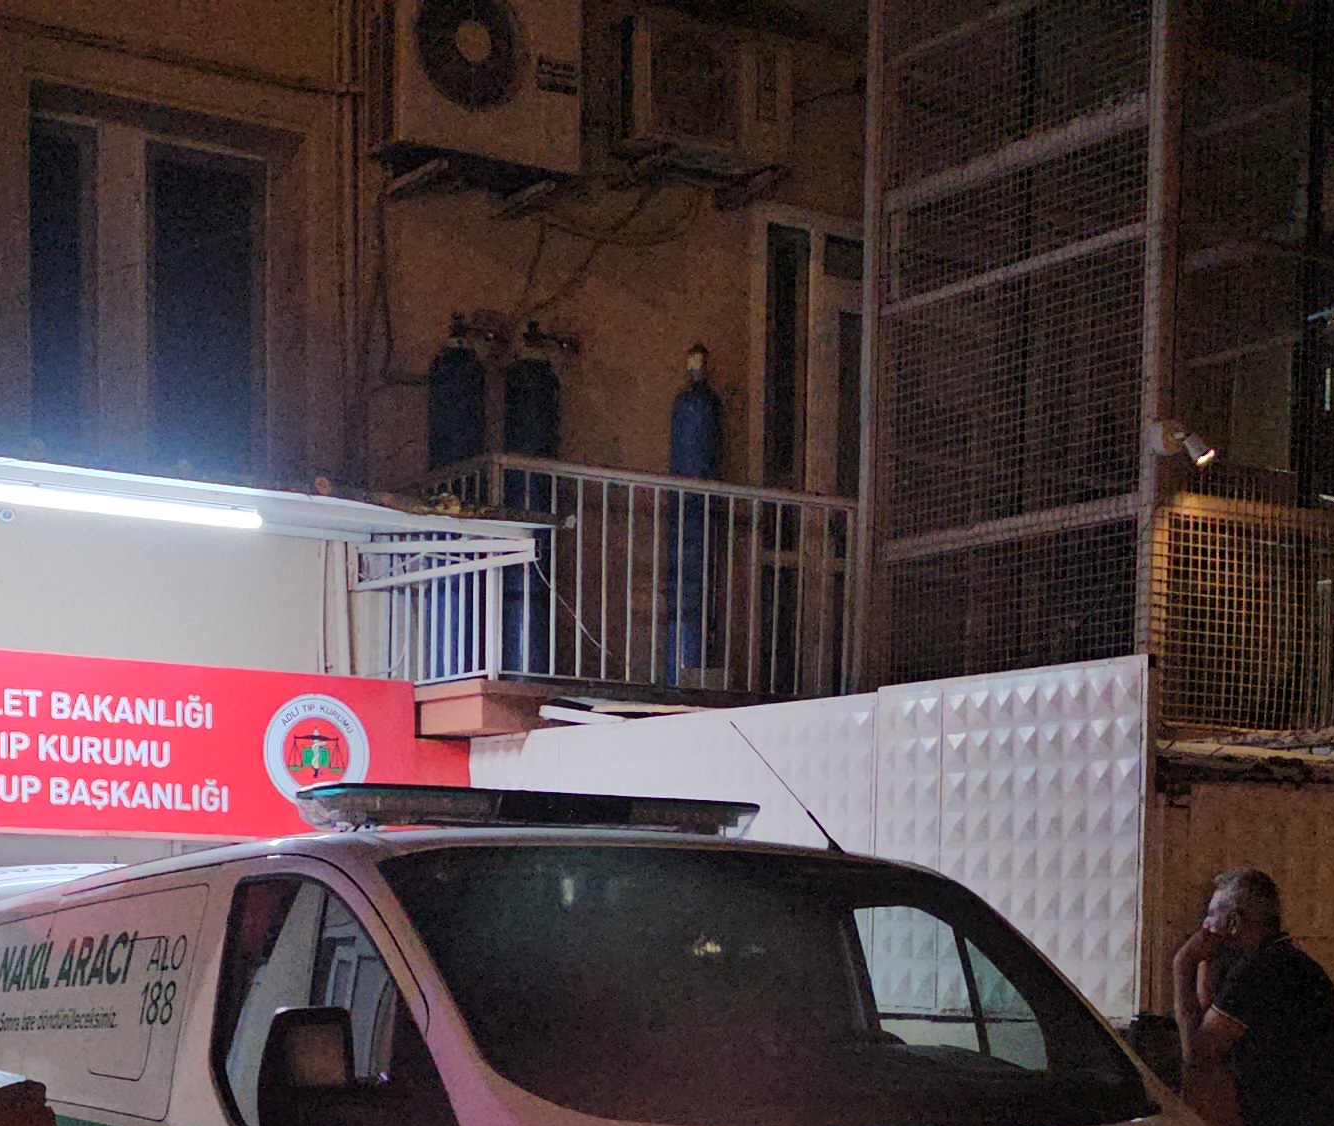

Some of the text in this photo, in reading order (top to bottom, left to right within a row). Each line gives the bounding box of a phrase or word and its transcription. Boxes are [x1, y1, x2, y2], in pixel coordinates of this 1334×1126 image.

[50, 690, 213, 729] BAKANLIĞI
[281, 703, 354, 734] ADLİ TIP KURUMU
[38, 733, 171, 768] KURUMU
[49, 776, 229, 813] BAŞKANLIĞI
[54, 930, 139, 988] ARACI
[146, 934, 188, 972] ALO
[139, 980, 177, 1026] 188
